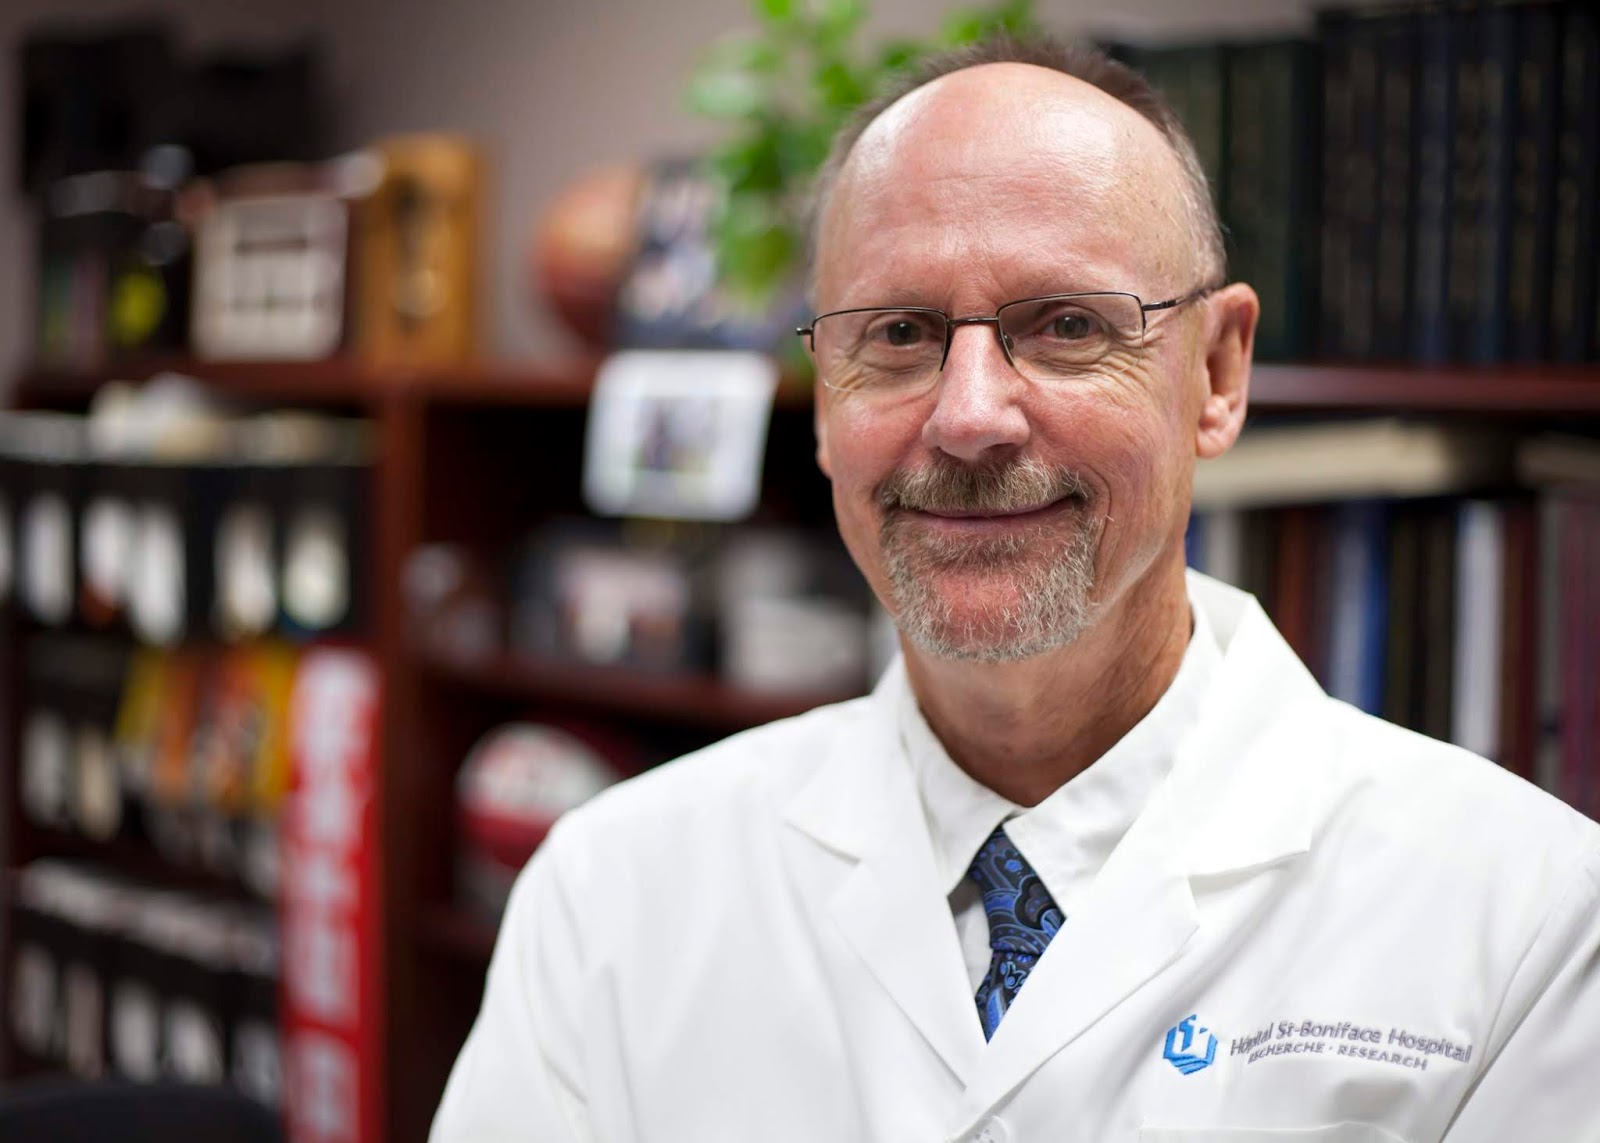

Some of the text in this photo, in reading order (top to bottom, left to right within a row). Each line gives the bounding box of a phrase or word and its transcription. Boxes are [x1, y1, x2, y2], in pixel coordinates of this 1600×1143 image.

[1276, 1020, 1382, 1043] St-Boniface
[1388, 1028, 1473, 1063] Hospital
[1337, 1045, 1428, 1071] RESEARCH
